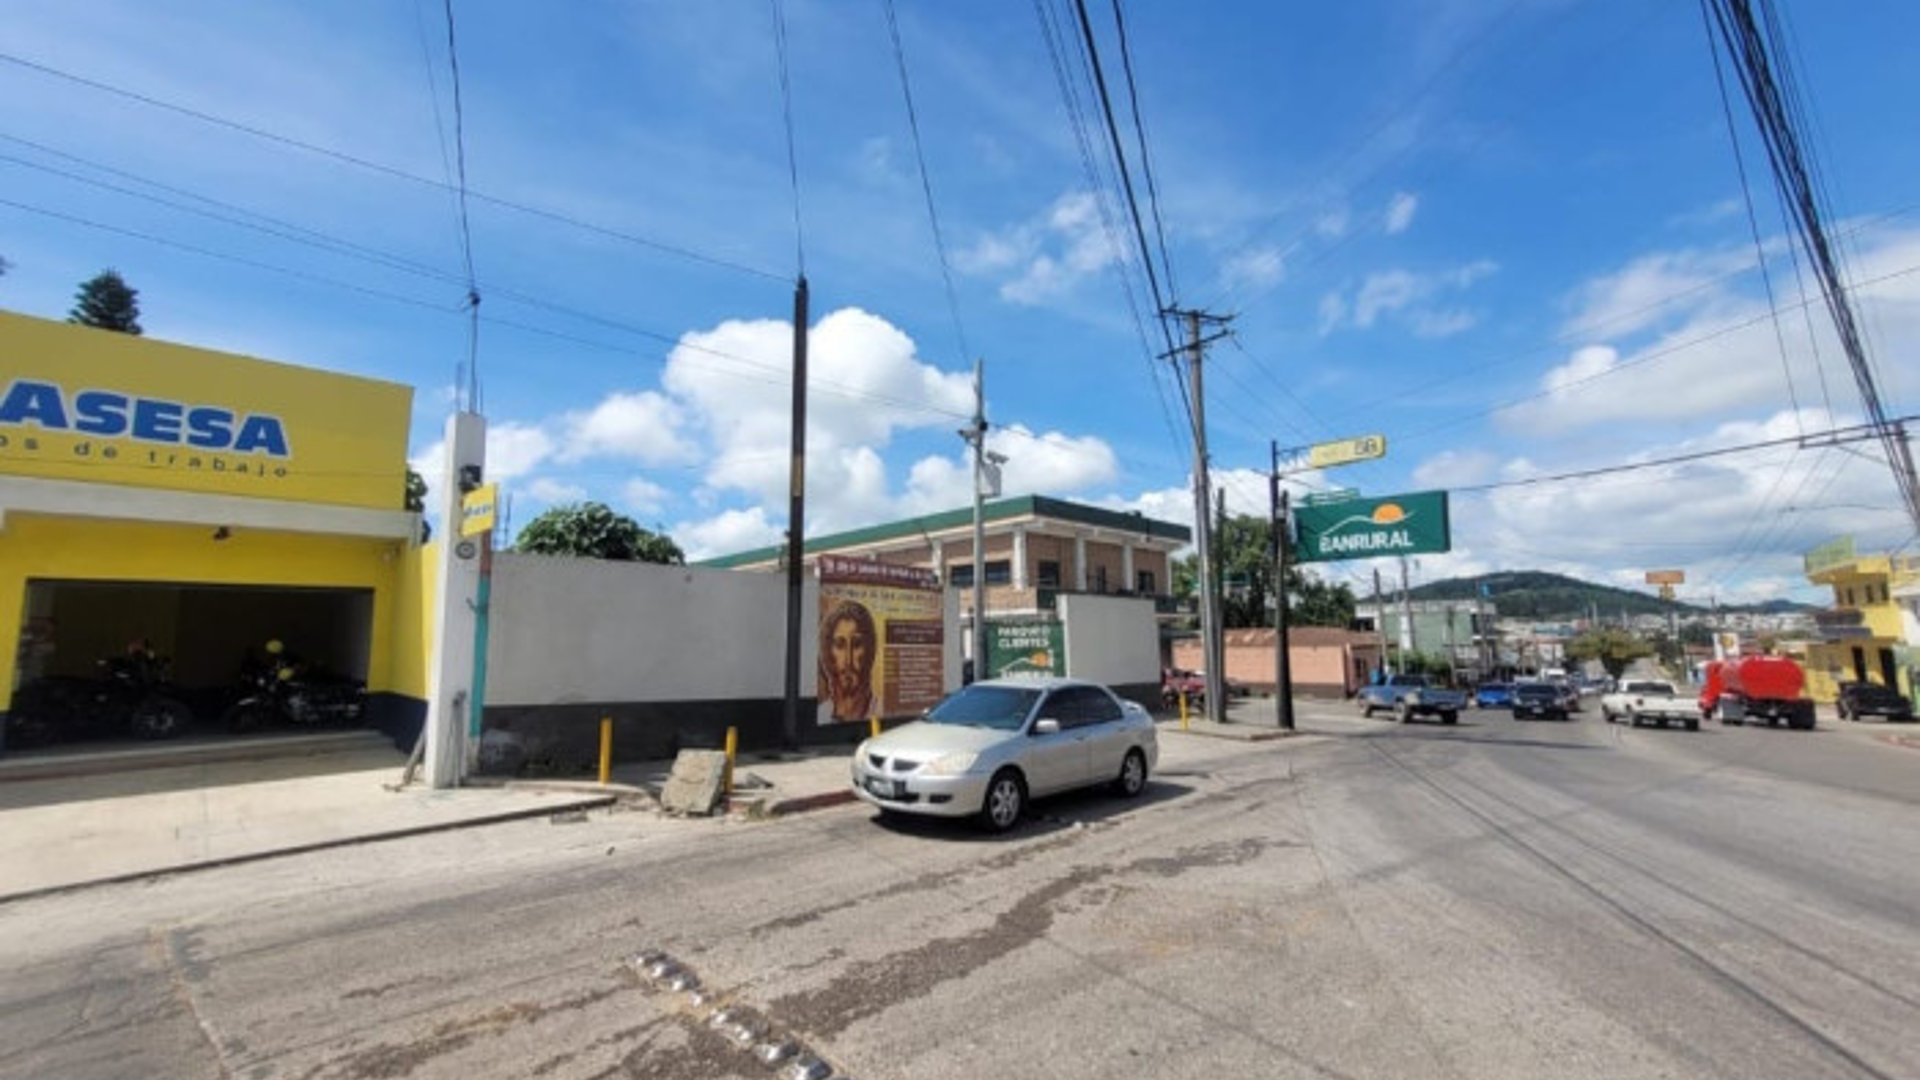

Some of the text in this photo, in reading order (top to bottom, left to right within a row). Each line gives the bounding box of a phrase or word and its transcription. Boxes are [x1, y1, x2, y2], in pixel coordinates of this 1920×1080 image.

[74, 441, 118, 459] de
[148, 450, 287, 478] trabajo
[1319, 530, 1413, 552] BANRURAL
[998, 626, 1050, 637] PARQUEO
[998, 638, 1049, 648] CLIENTES
